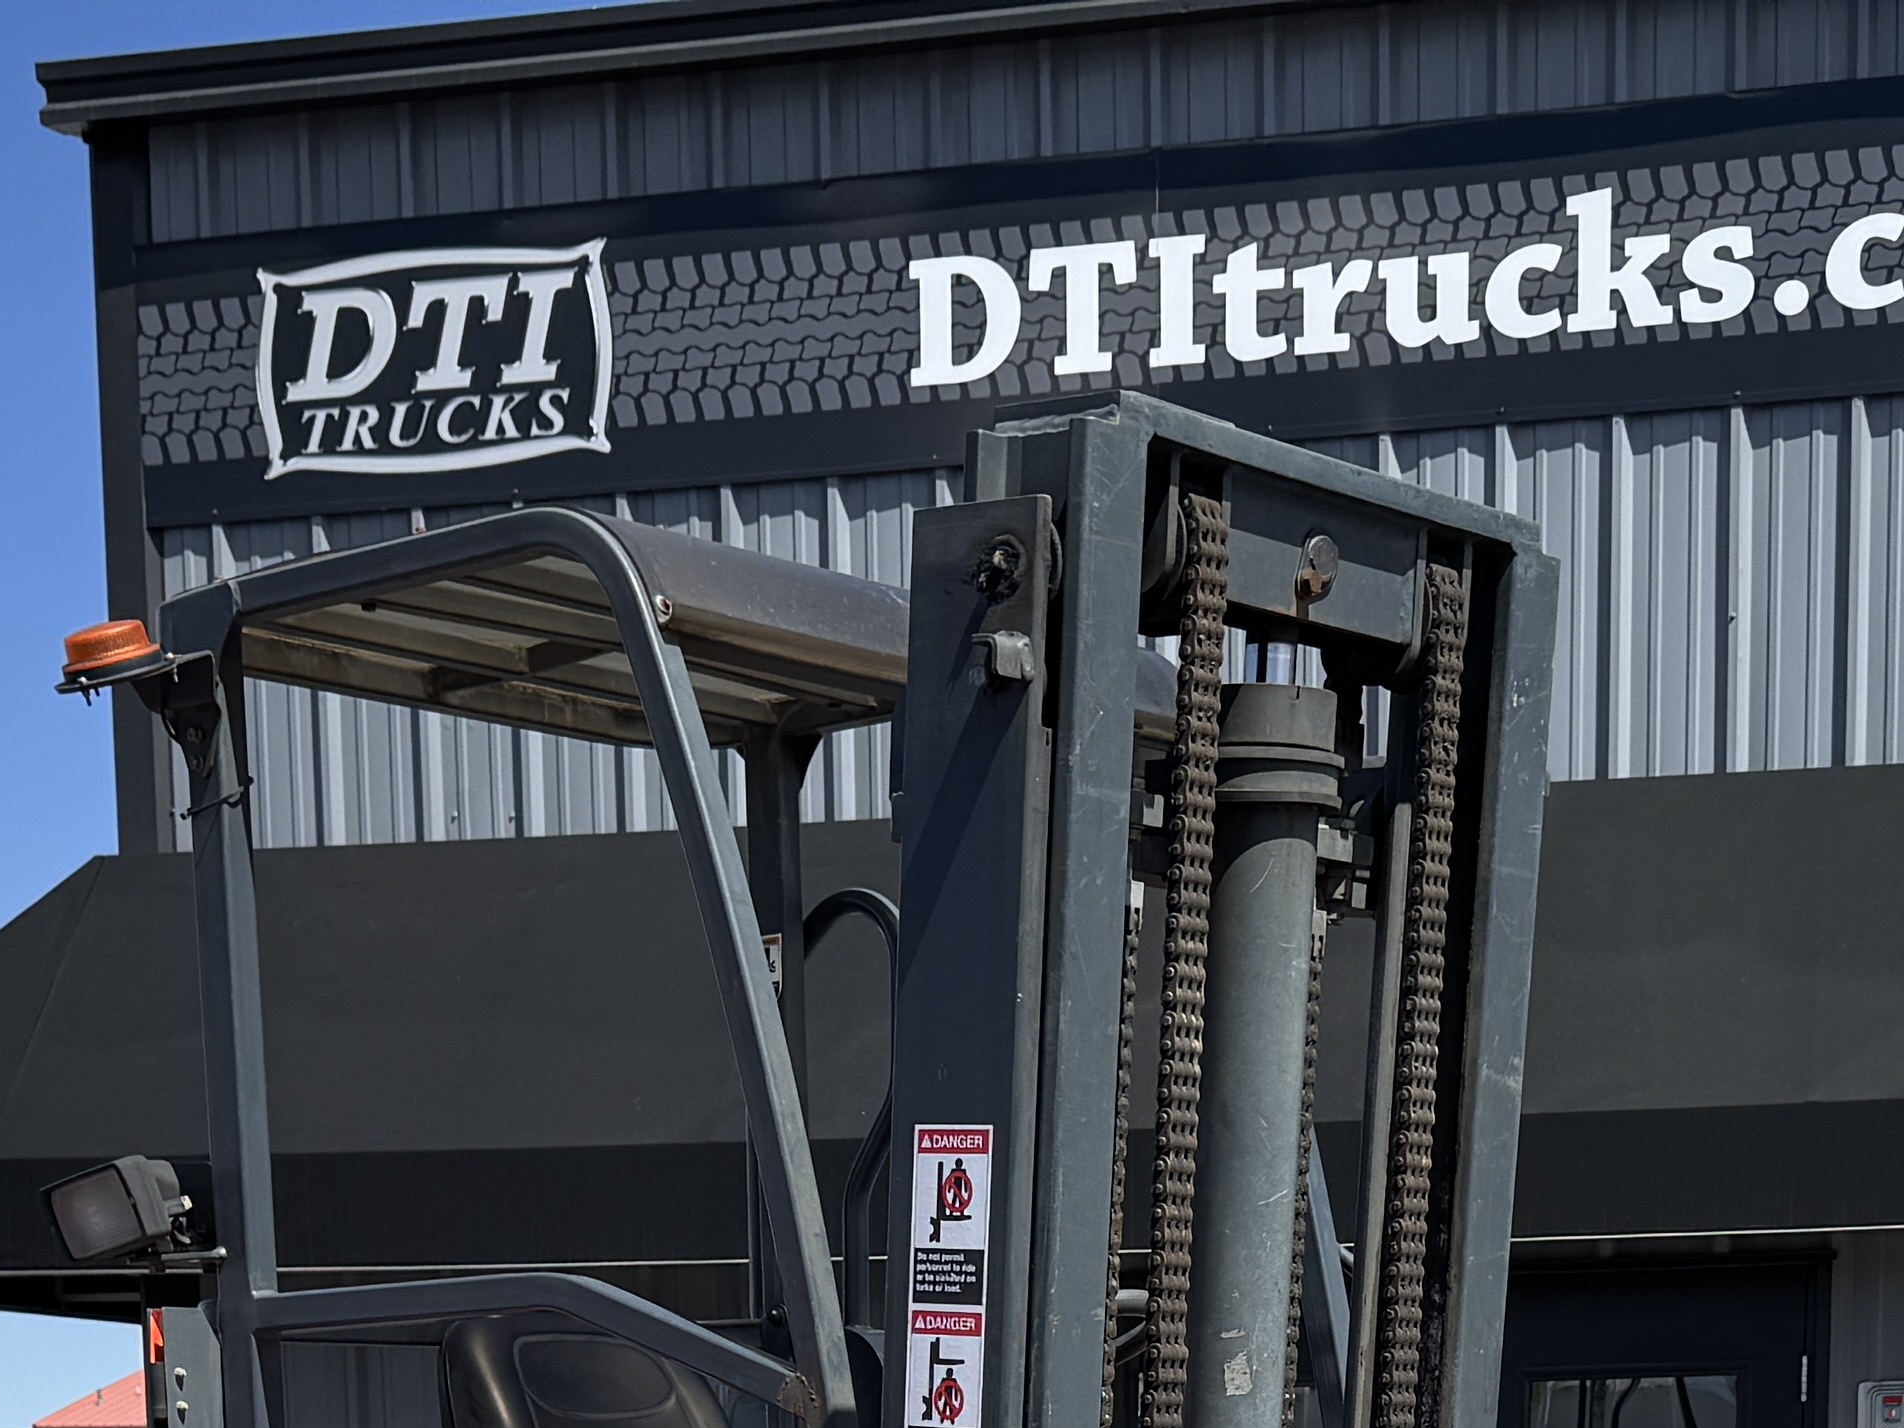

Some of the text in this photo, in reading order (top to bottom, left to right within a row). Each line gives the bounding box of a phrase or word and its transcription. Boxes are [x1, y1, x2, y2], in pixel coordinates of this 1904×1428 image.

[282, 267, 578, 404] DTI
[300, 388, 570, 455] TRUCKS
[933, 1134, 983, 1149] DANGER
[926, 1315, 976, 1330] DANGER
